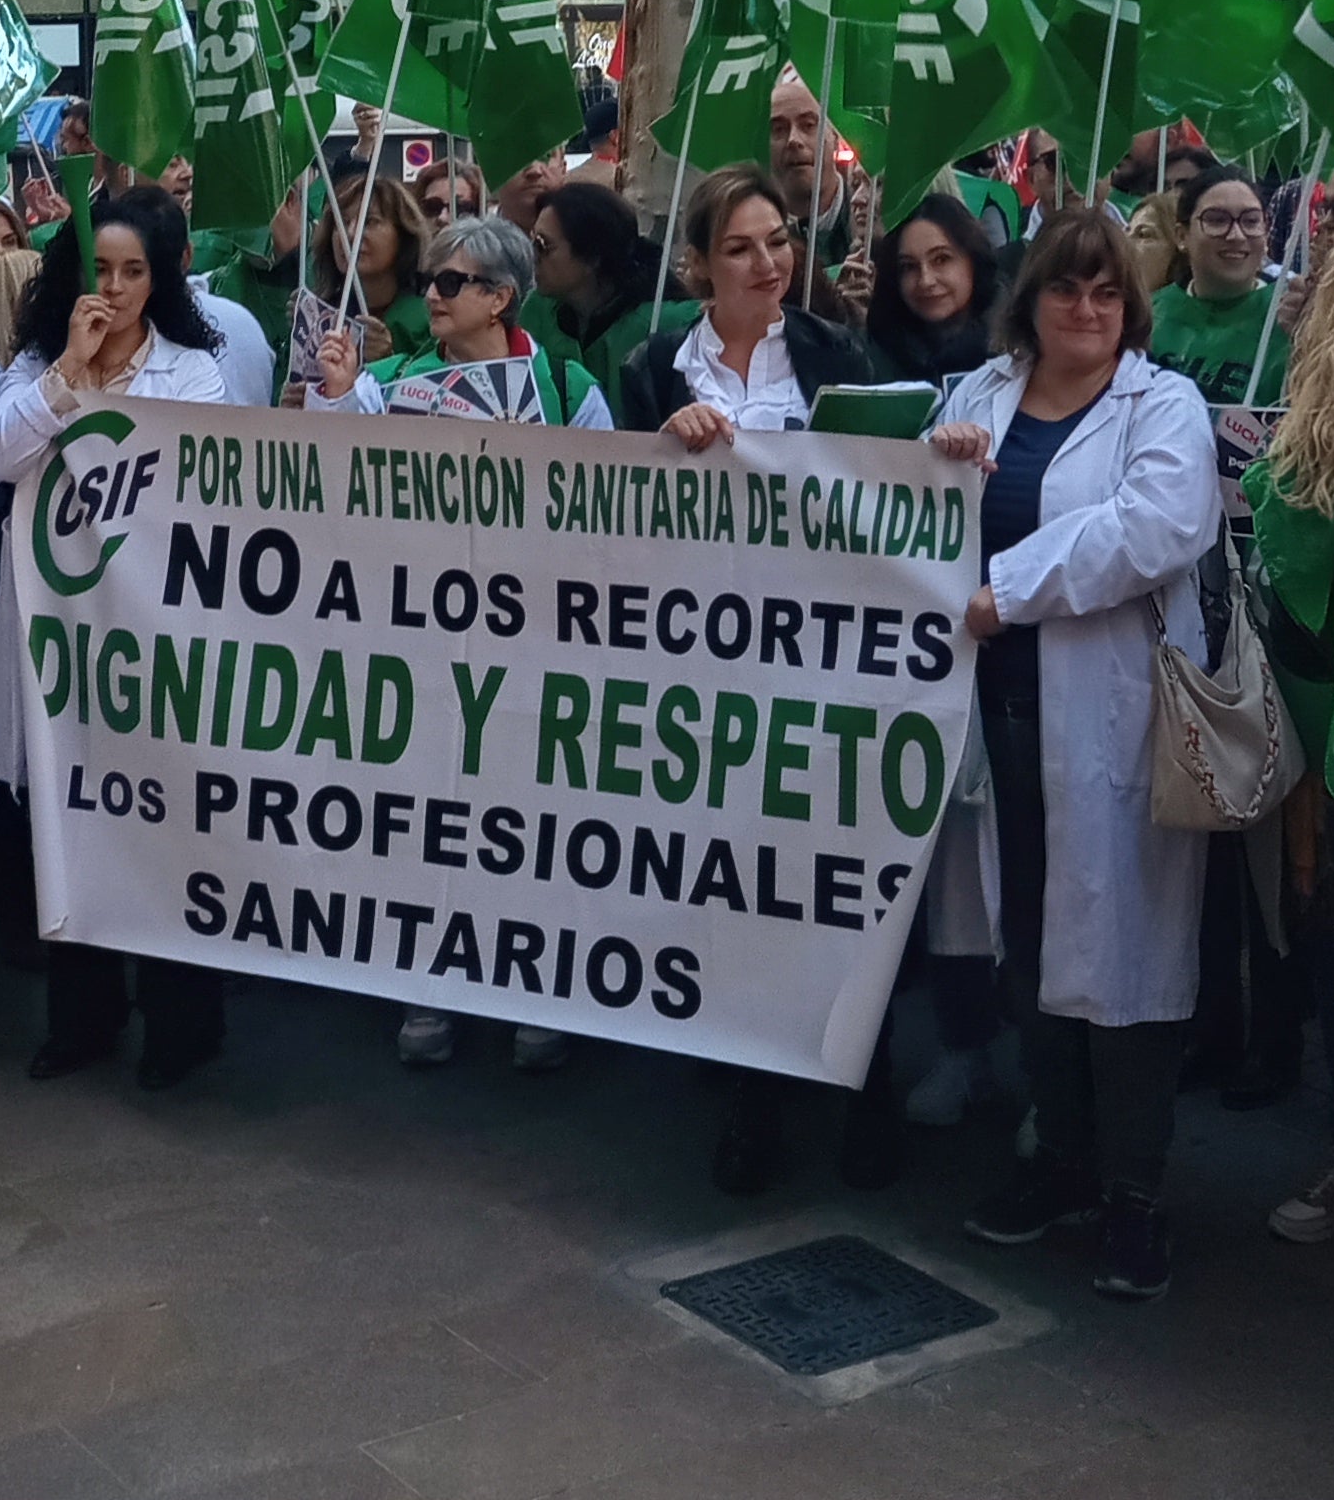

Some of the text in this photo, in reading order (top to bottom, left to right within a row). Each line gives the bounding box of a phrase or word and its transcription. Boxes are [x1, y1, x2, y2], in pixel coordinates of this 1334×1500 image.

[177, 434, 965, 562] POR UNA ATENCIÓN SANITARIA DE CALIDAD
[162, 522, 955, 683] NO A LOS RECORTES
[28, 614, 946, 839] DIGNIDAD Y RESPETO
[67, 764, 167, 824] LOS
[183, 870, 703, 1021] SANITARIOS
